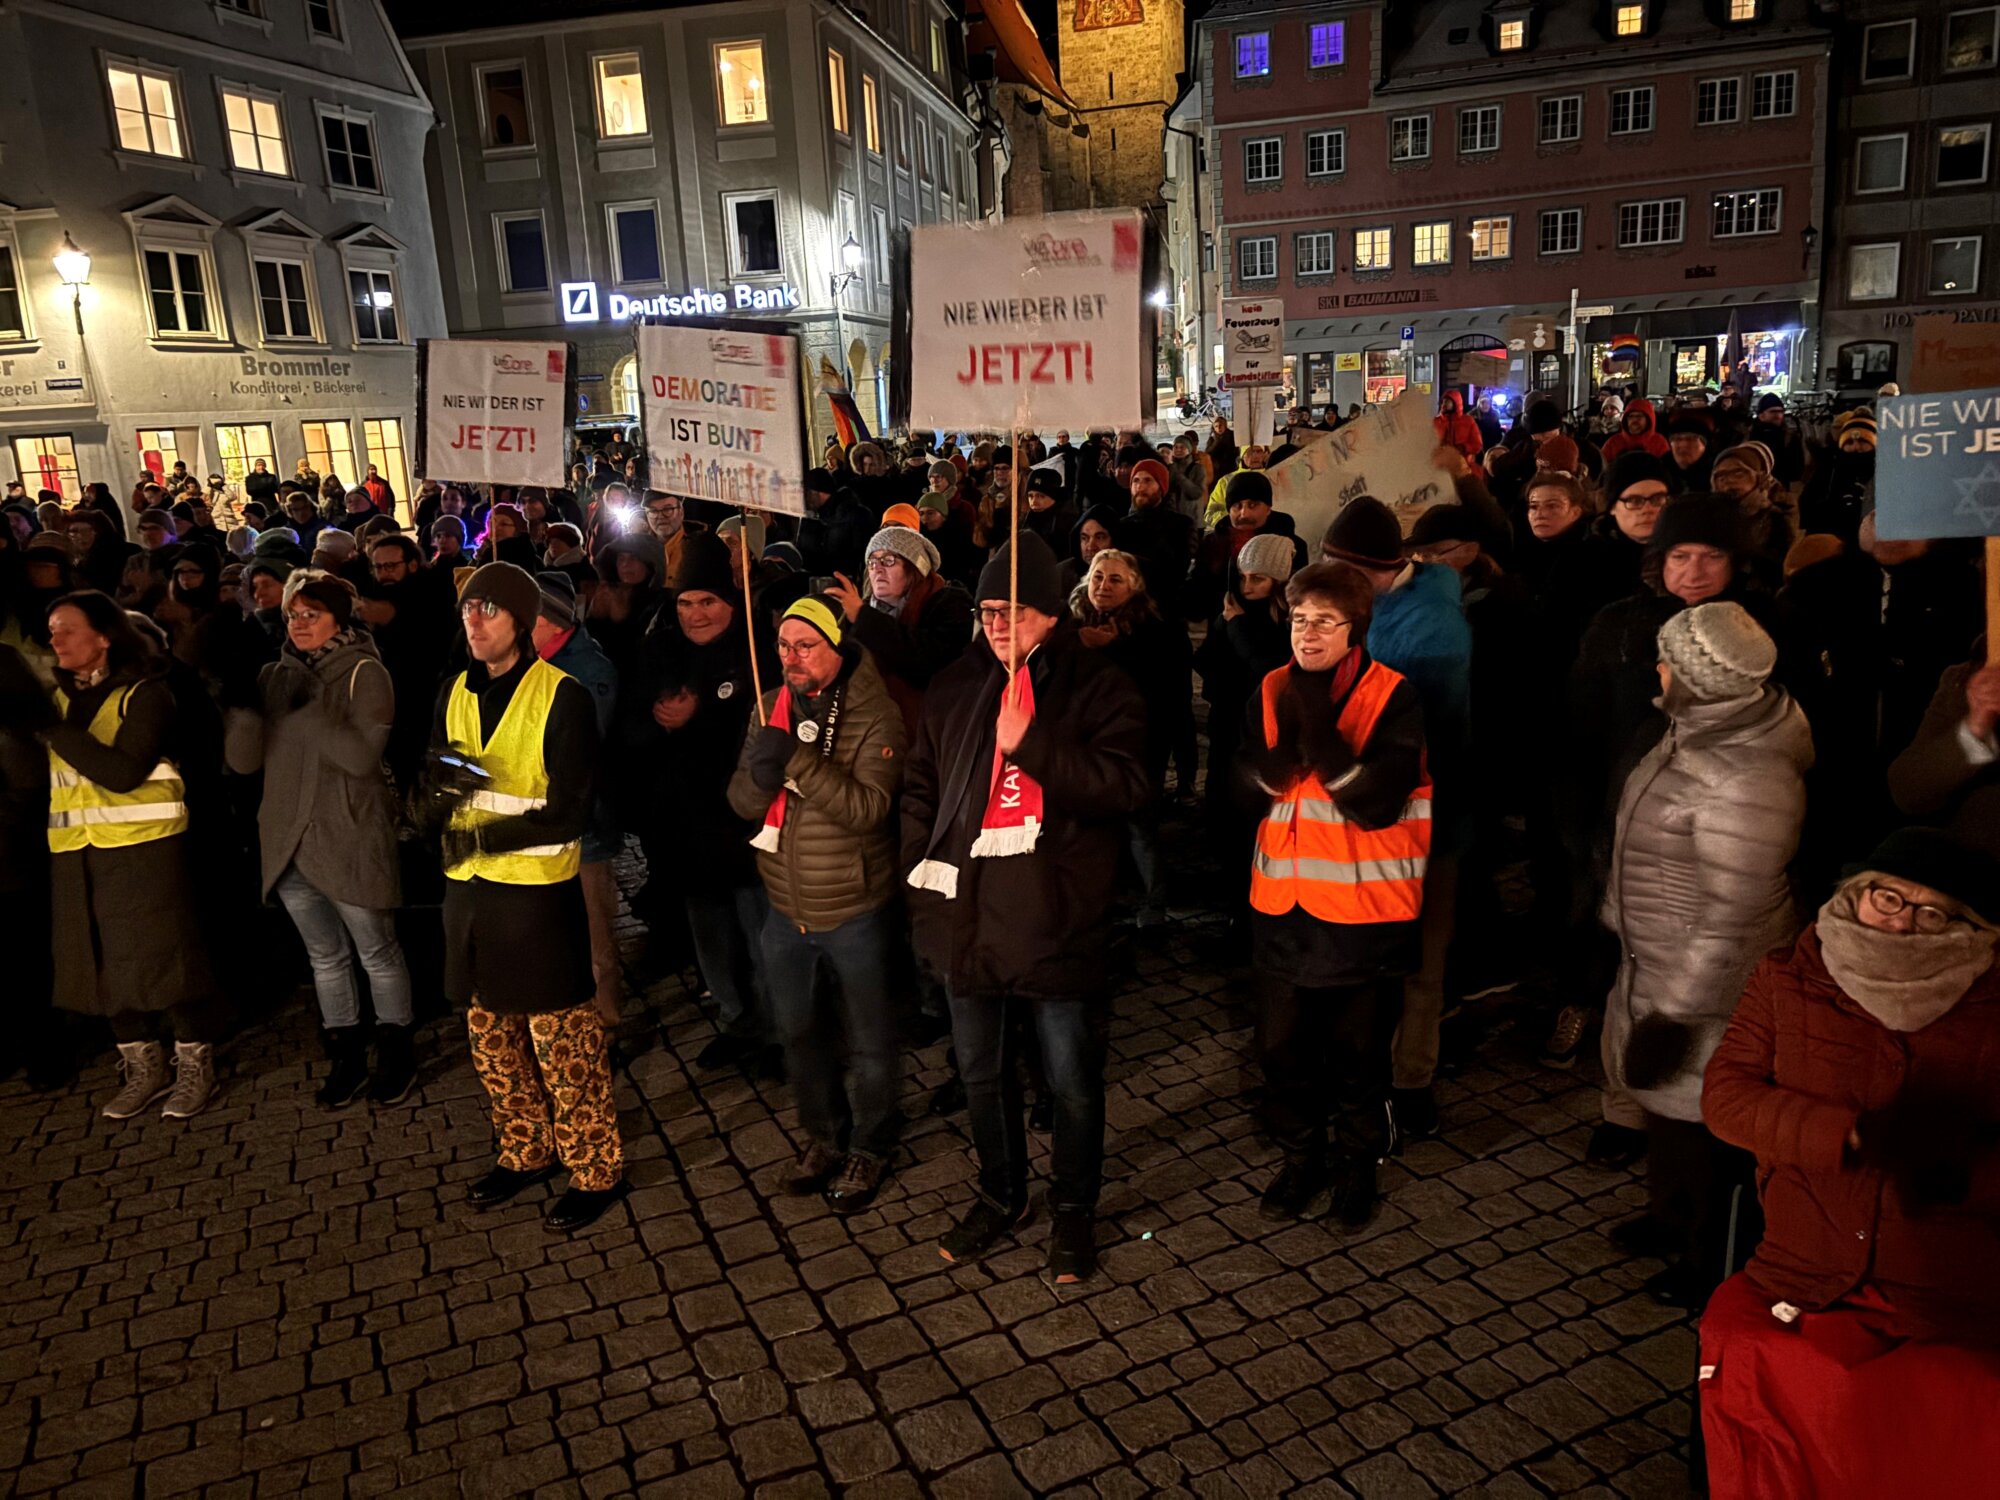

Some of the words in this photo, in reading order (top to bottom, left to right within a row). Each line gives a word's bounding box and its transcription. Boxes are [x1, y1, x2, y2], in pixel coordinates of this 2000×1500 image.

[610, 288, 727, 320] Deutsche
[734, 283, 800, 309] Bank
[943, 301, 979, 327] NIE
[983, 297, 1067, 324] WIEDER
[1073, 294, 1107, 320] IST
[1320, 296, 1339, 309] SKL
[1347, 291, 1417, 306] BAUMANN
[1225, 317, 1280, 328] Feuerzeug
[240, 355, 351, 376] Brommler
[957, 340, 1093, 385] JETZT!
[1246, 360, 1259, 368] für
[230, 380, 302, 394] Konditorei
[313, 380, 366, 393] Bäckerei
[443, 395, 465, 408] NIE
[468, 395, 519, 410] WIDER
[522, 397, 545, 411] IST
[1881, 402, 1941, 430] NIE
[450, 425, 536, 453] JETZT!
[671, 418, 701, 443] IST
[707, 423, 765, 453] BUNT
[1901, 431, 1957, 459] IST
[821, 726, 835, 757] DICH
